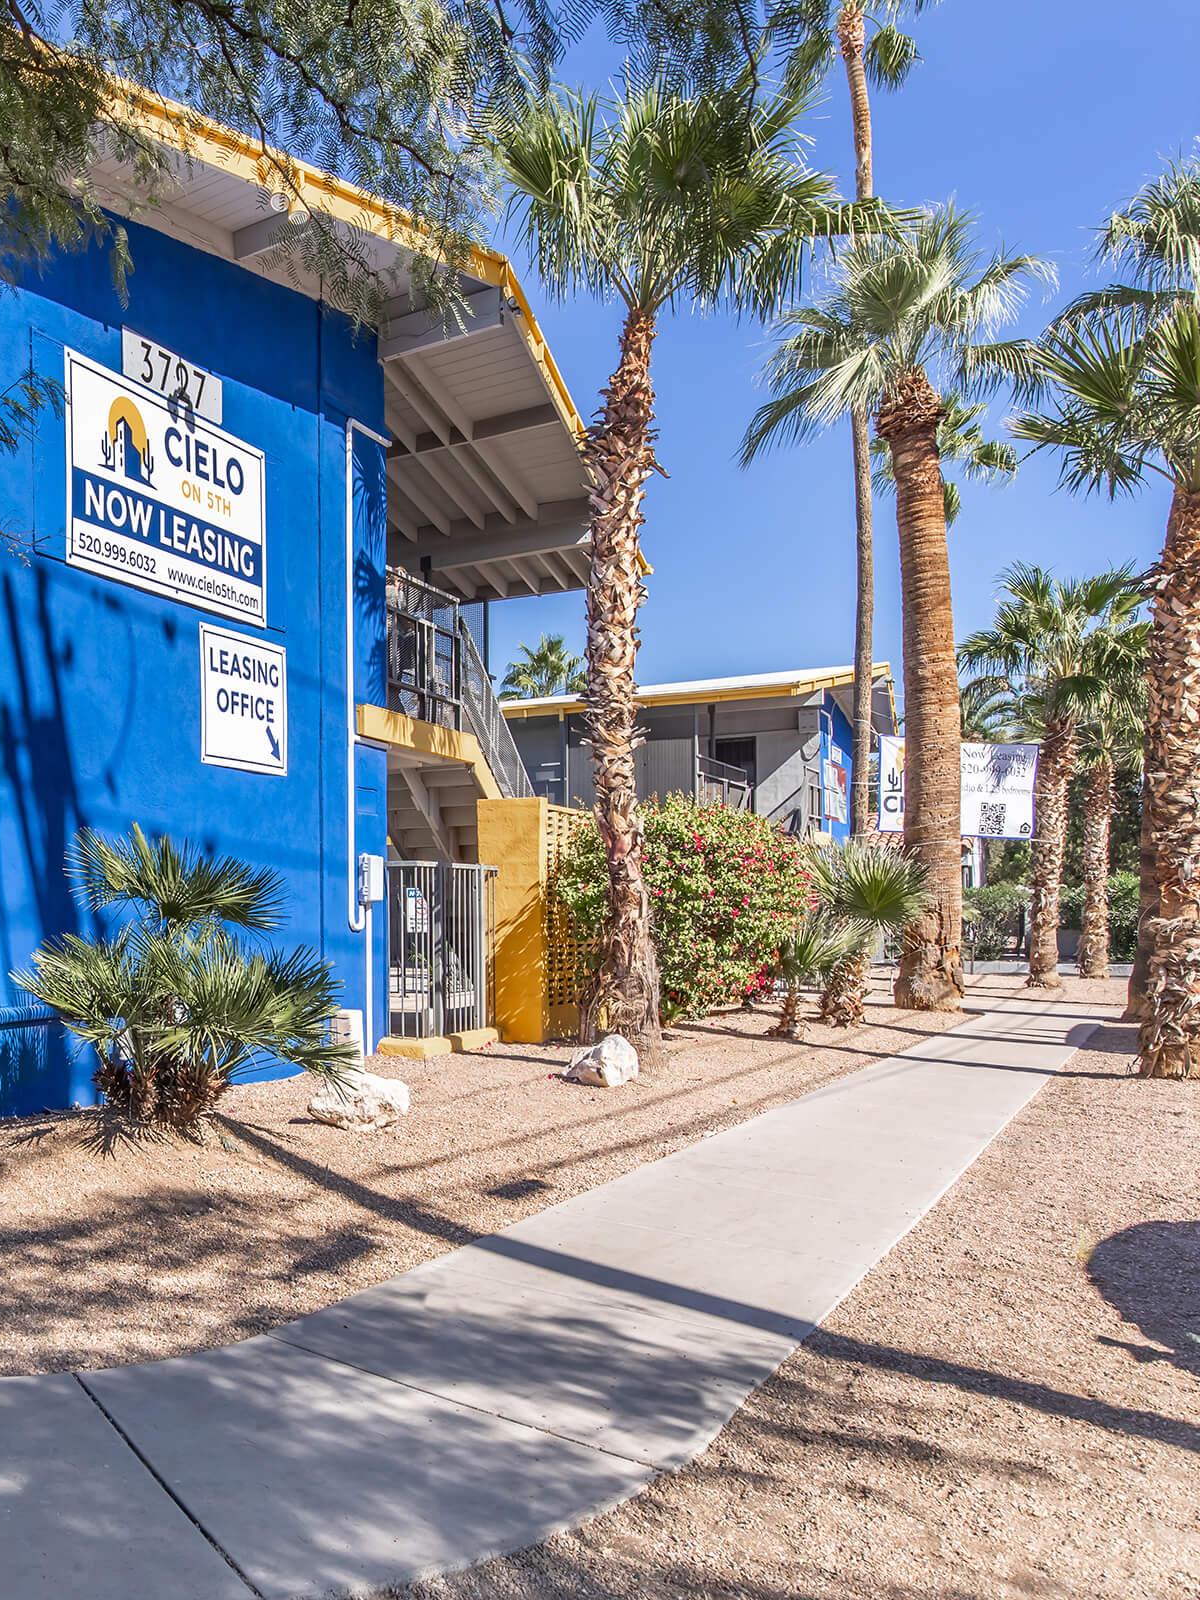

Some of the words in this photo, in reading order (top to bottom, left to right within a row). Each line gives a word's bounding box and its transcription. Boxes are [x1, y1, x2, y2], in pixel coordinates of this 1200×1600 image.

[141, 341, 206, 409] 3727
[165, 427, 244, 495] CIELO
[181, 479, 203, 505] ON
[208, 490, 232, 517] 5TH
[85, 479, 154, 537] NOW
[160, 510, 256, 577] LEASING
[78, 533, 157, 575] 520.999.6032
[167, 566, 259, 611] www.cielo5th.com
[209, 646, 280, 689] LEASING
[216, 687, 275, 724] OFFICE
[963, 747, 985, 759] Now
